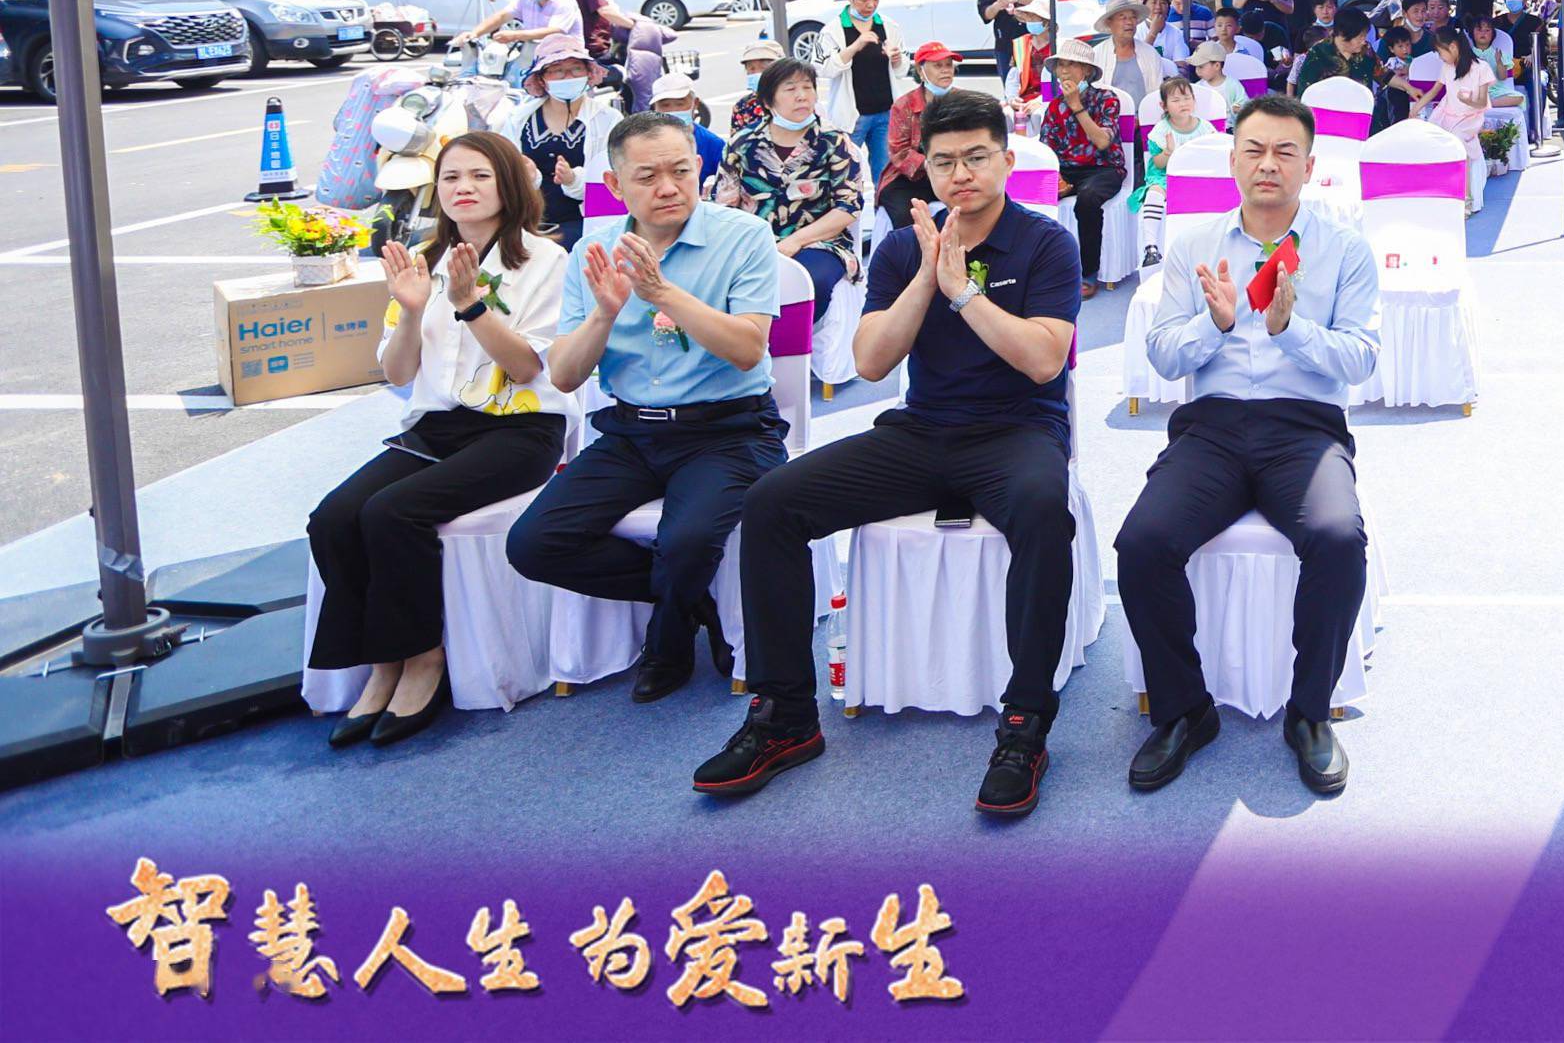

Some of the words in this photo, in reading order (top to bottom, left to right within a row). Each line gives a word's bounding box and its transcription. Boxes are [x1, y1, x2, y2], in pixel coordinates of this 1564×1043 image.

[238, 317, 313, 341] Haier
[239, 342, 276, 355] smart
[278, 336, 314, 349] home
